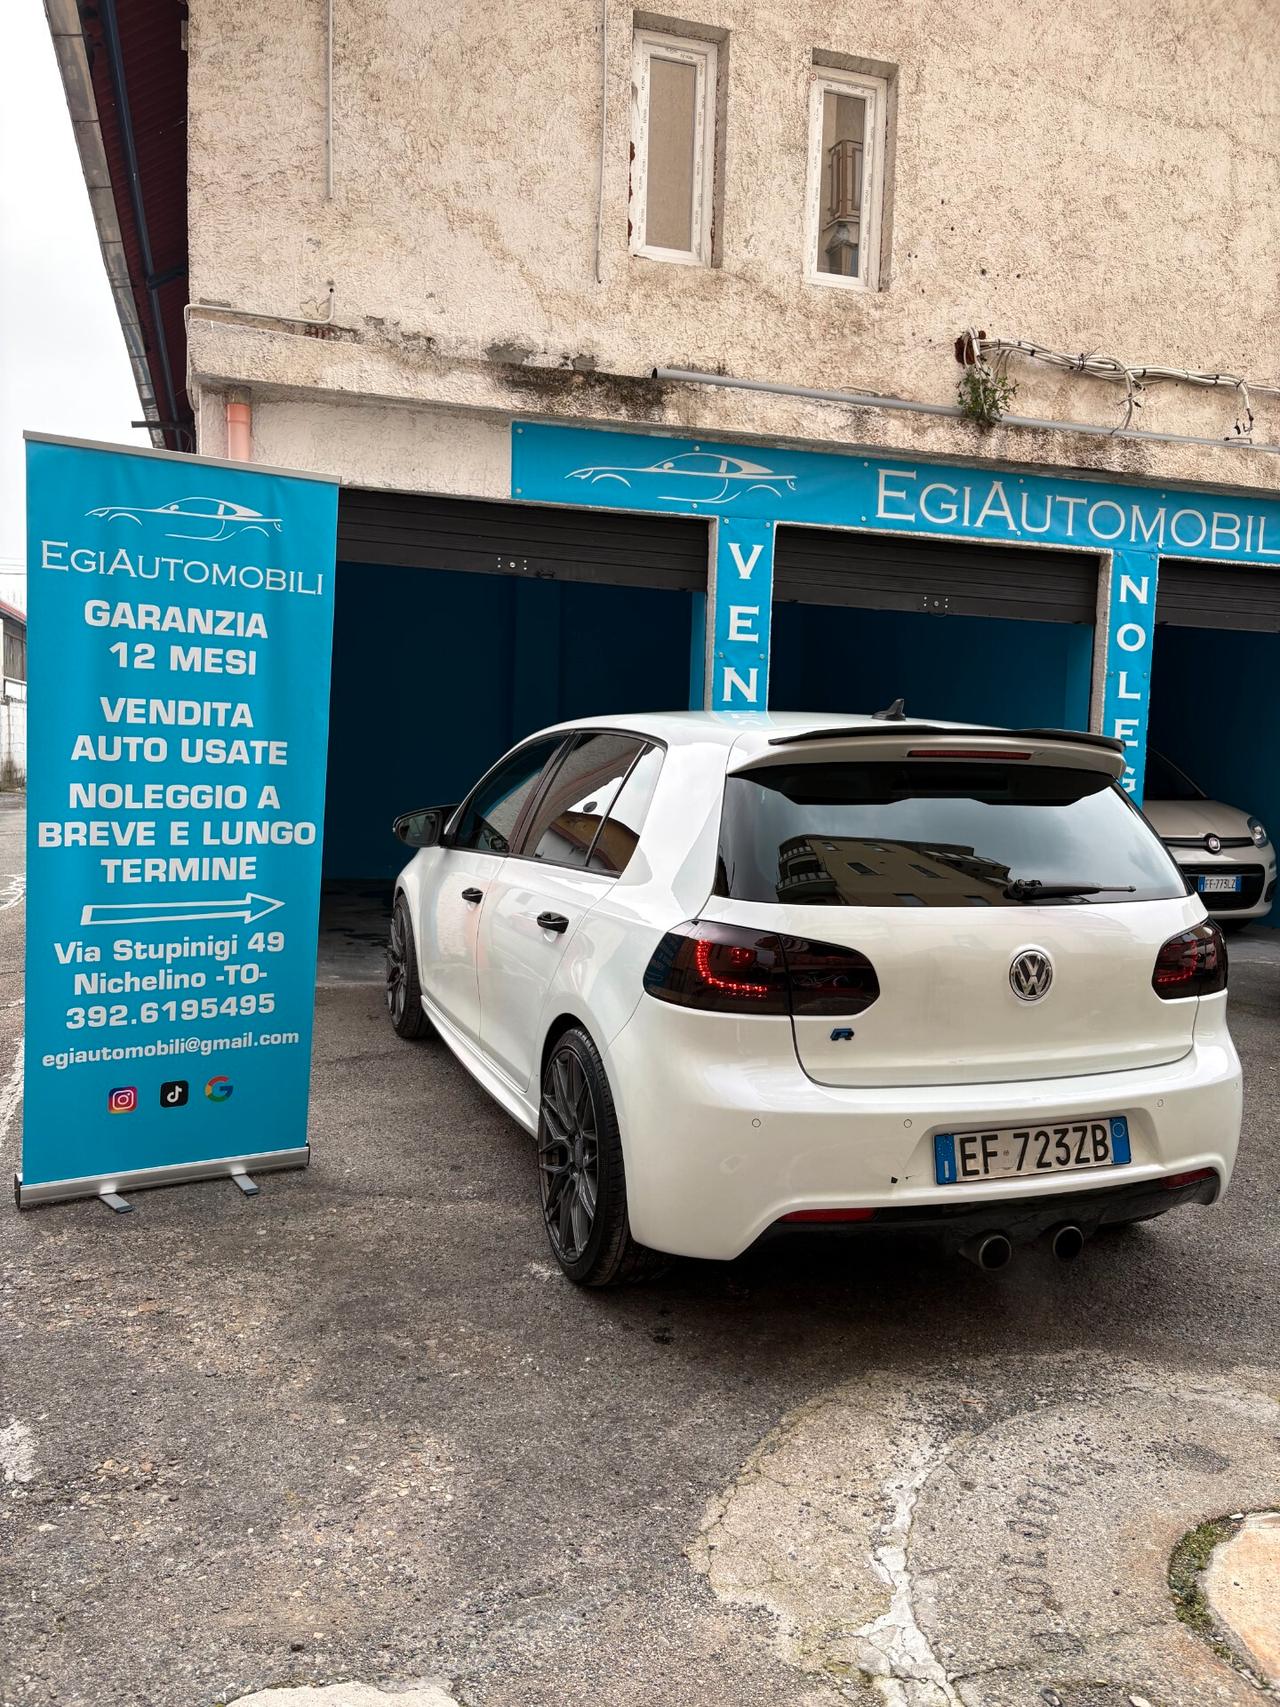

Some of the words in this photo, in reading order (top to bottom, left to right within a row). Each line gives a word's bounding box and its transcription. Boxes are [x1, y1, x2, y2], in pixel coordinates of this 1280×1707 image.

[85, 600, 268, 638] GARANZIA
[110, 642, 155, 670] 12
[170, 646, 257, 675] MESI
[100, 697, 254, 728] VENDITA
[71, 735, 167, 762] AUTO
[181, 739, 288, 765] USATE
[69, 784, 247, 809] NOLEGGIO
[257, 786, 281, 809] A
[38, 822, 156, 848] BREVE
[170, 822, 189, 846] E
[203, 822, 316, 846] LUNGO
[101, 857, 257, 884] TERMINE
[54, 942, 100, 964] Via
[113, 935, 238, 964] Stupinigi
[247, 931, 285, 953] 49
[74, 968, 206, 995] Nichelino
[216, 963, 267, 985] -TO-
[66, 993, 275, 1029] 392.6195495
[42, 1031, 299, 1068] egiautomobili@gmail.com
[959, 1134, 998, 1177] EF
[1013, 1124, 1110, 1172] 723ZB
